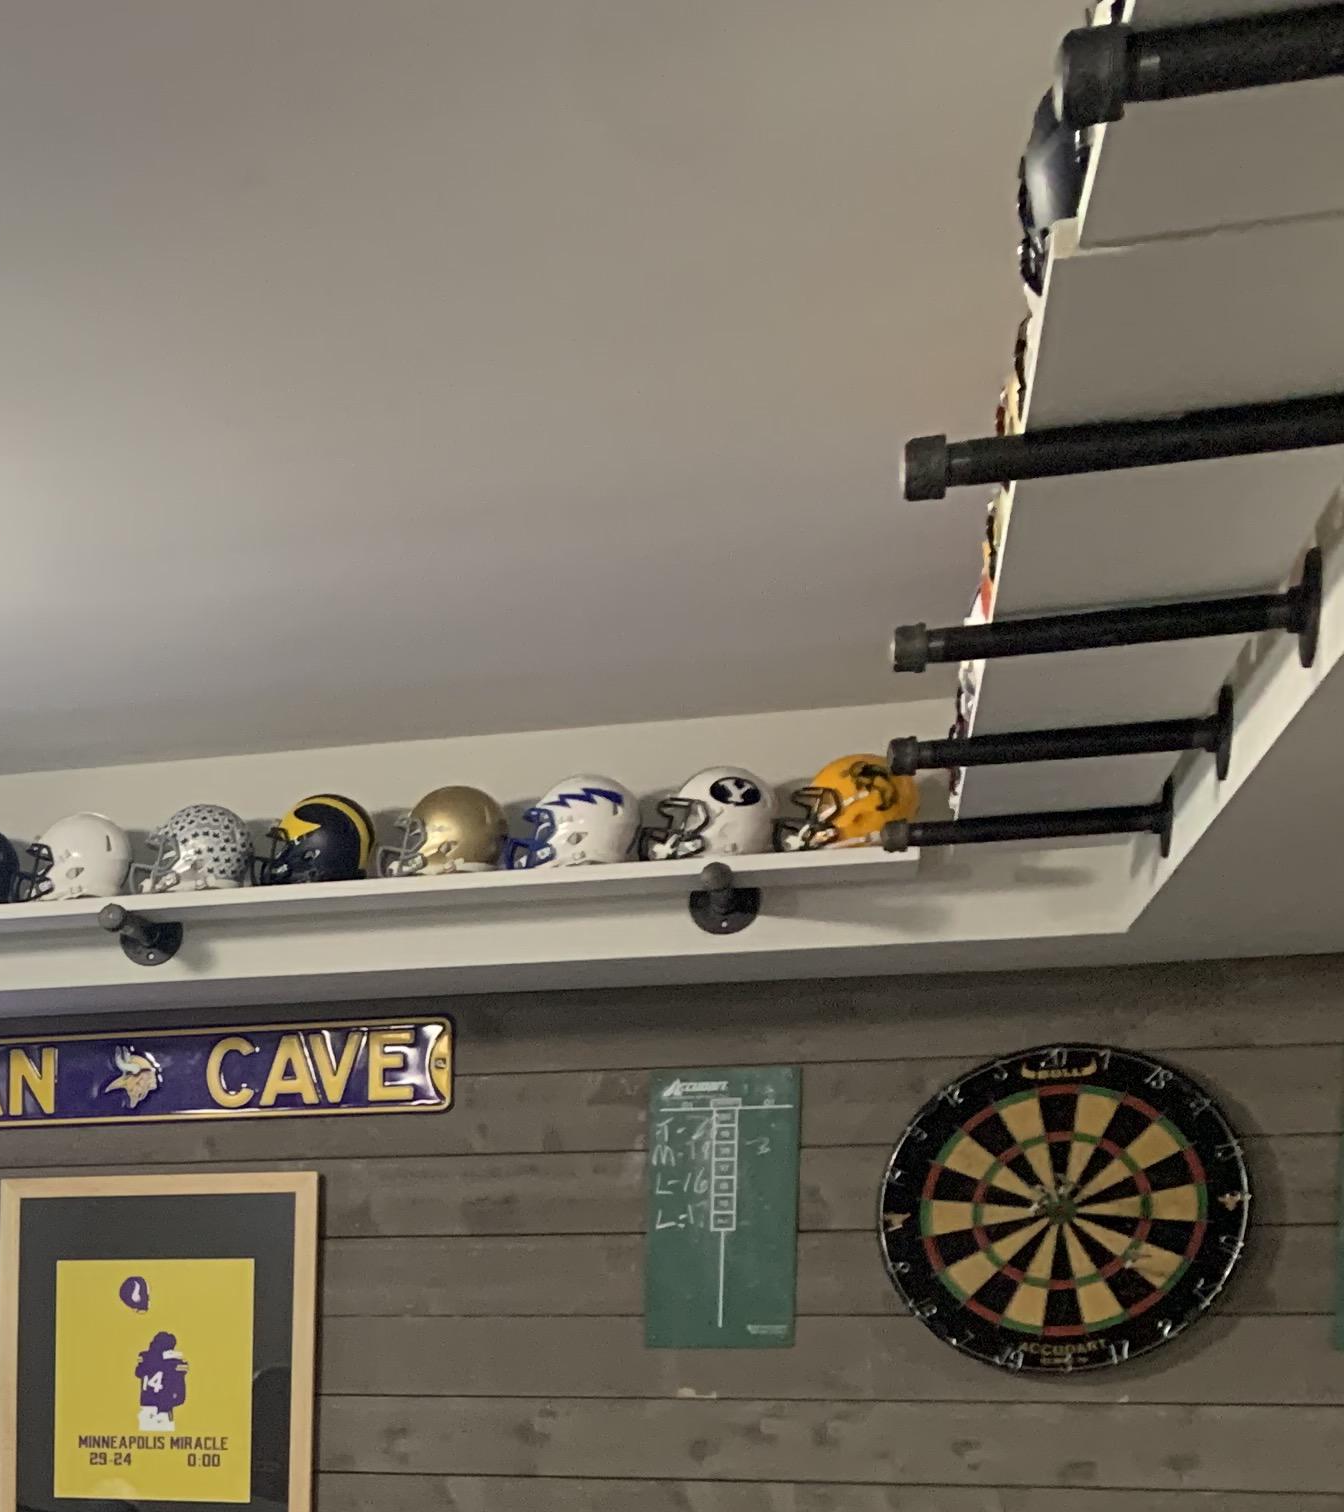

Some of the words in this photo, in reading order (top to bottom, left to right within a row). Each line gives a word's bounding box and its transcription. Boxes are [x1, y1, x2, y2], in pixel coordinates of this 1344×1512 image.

[205, 1030, 415, 1109] CAVE
[143, 1371, 164, 1393] 14
[78, 1435, 165, 1450] MINNEAPOLIS
[170, 1436, 229, 1451] MIRACLE
[187, 1453, 221, 1467] 0:00
